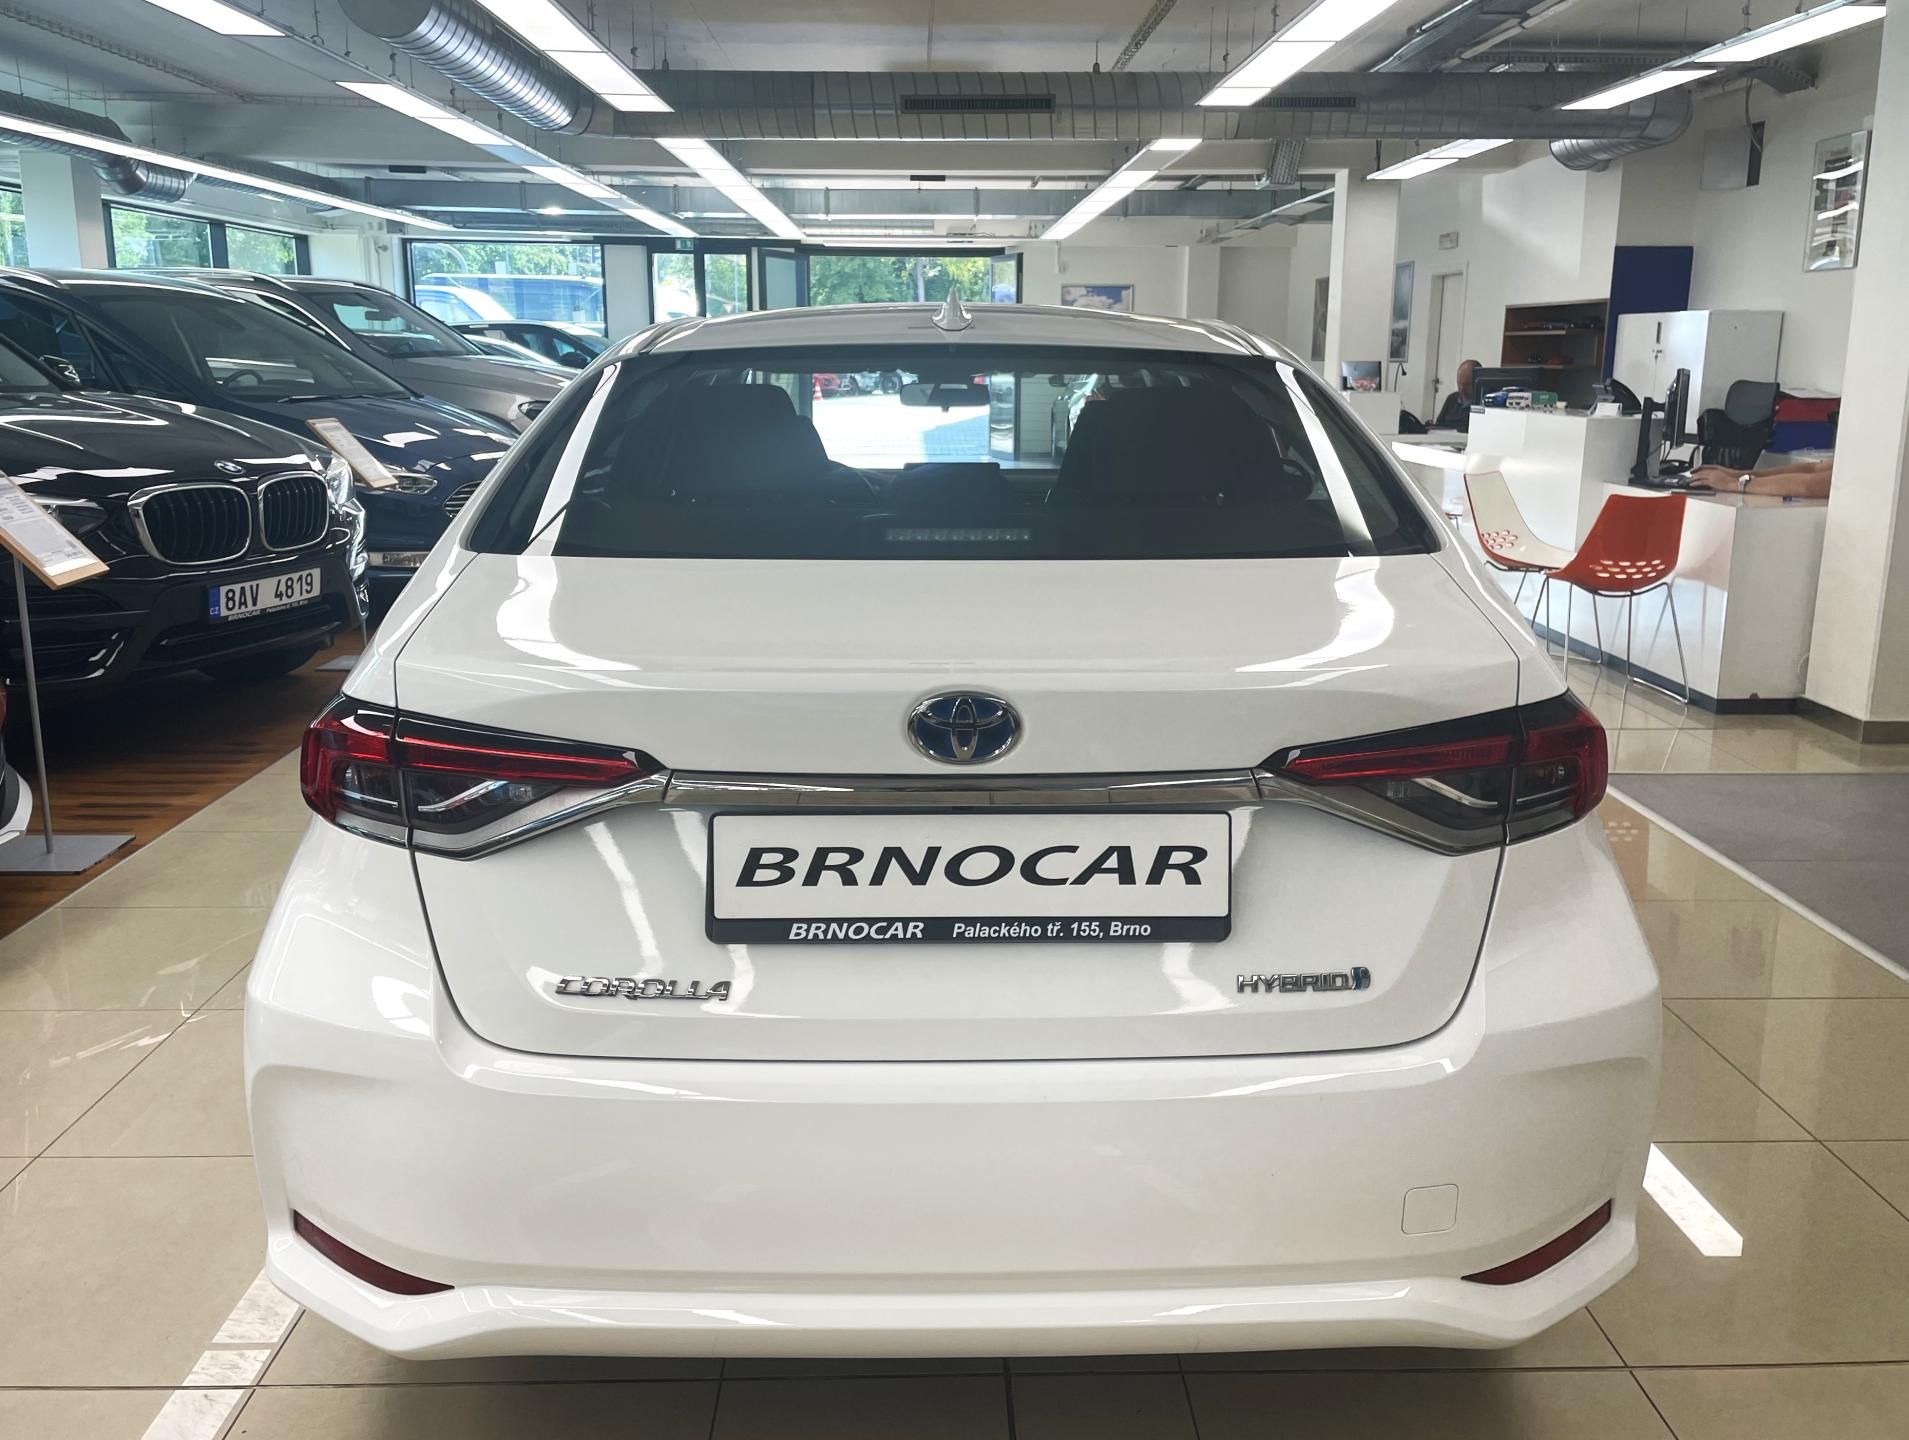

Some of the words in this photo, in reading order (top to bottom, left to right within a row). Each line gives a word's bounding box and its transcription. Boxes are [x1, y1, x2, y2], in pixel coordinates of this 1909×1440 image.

[225, 584, 259, 611] 8AV
[274, 572, 314, 601] 4819
[209, 606, 219, 615] CZ
[735, 844, 1208, 887] BRNOCAR
[788, 921, 925, 940] BRNOCAR
[952, 921, 1042, 938] Palackého
[1046, 921, 1064, 937] tř.
[1070, 921, 1104, 939] 155,
[1109, 921, 1151, 936] Brno
[556, 976, 732, 1001] COROLLA
[1237, 972, 1350, 993] HYBRID
